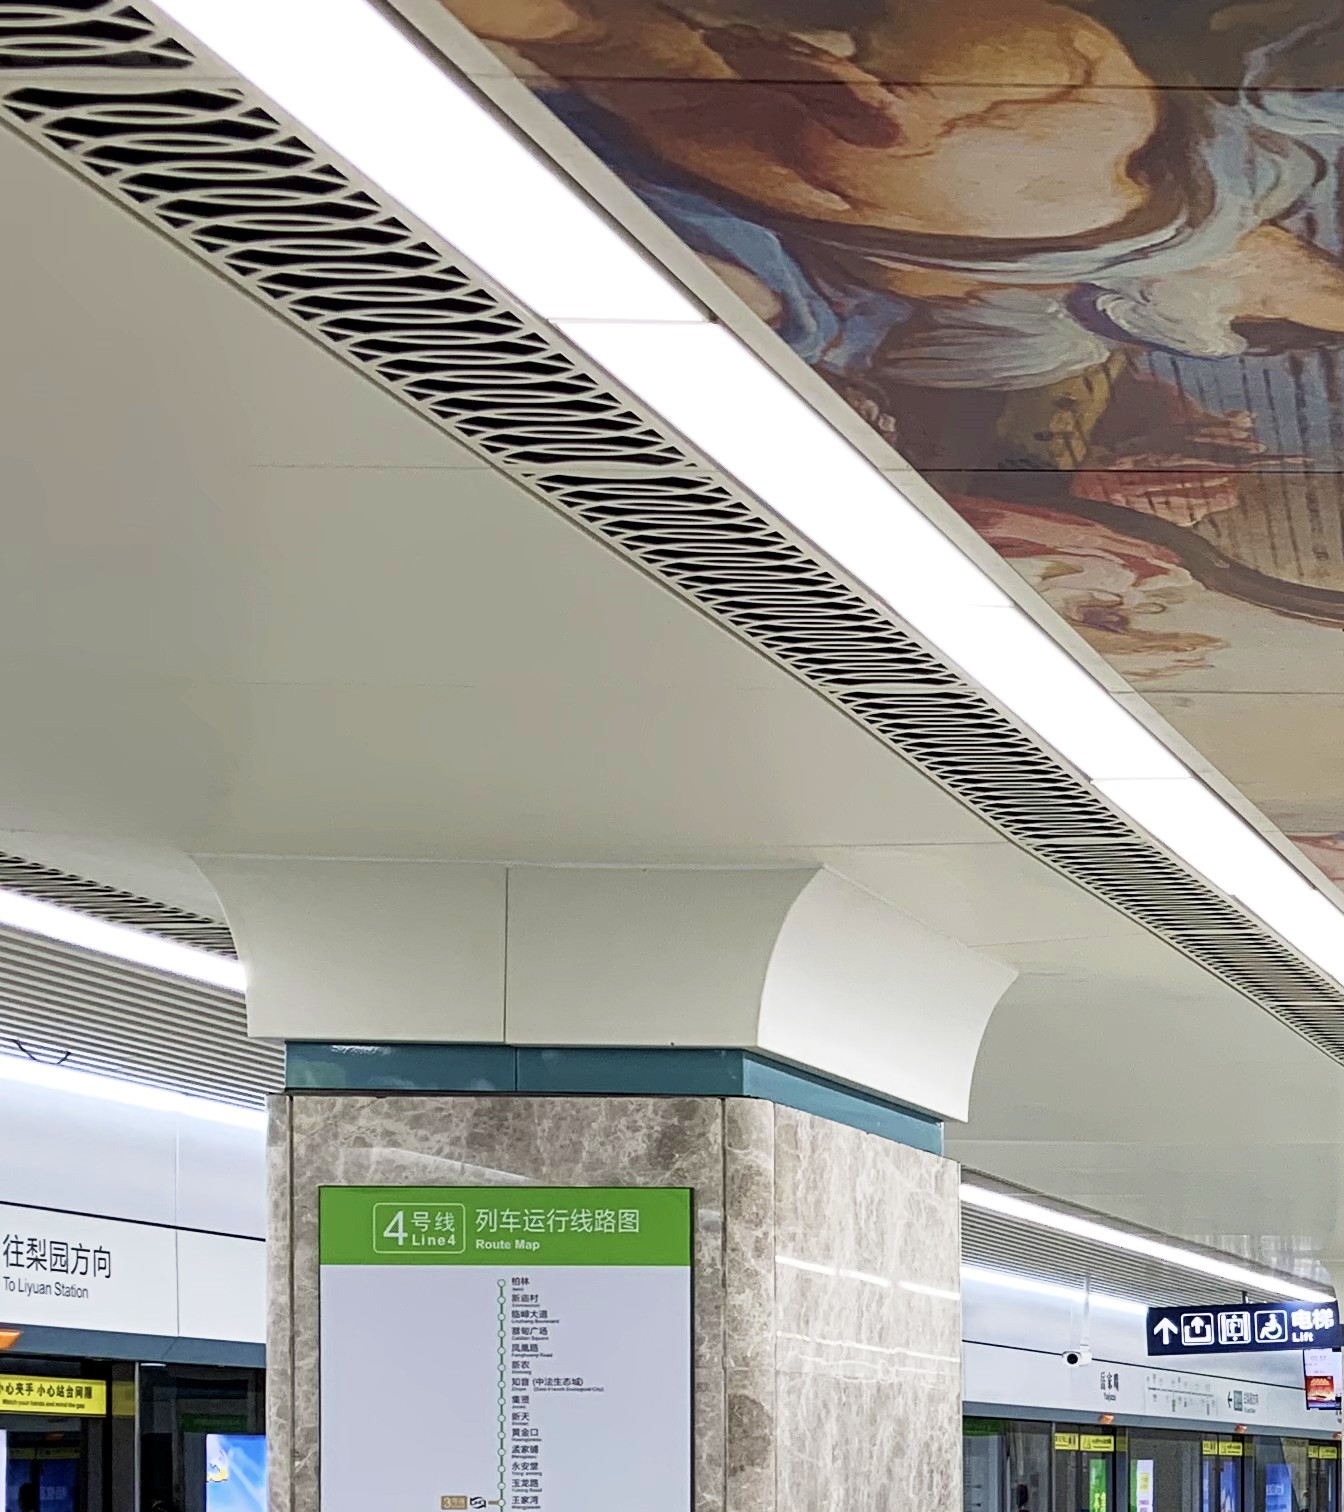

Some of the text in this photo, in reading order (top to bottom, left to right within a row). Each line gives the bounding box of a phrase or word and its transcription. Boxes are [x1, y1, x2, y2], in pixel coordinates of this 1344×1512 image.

[475, 1208, 640, 1234] 列车运行线路图
[2, 1233, 112, 1279] 往梨园方向
[475, 1238, 511, 1250] Route
[515, 1238, 540, 1252] Map
[2, 1276, 89, 1299] To Liyuan Station
[1291, 1308, 1335, 1331] 电梯
[1292, 1331, 1315, 1343] Lift
